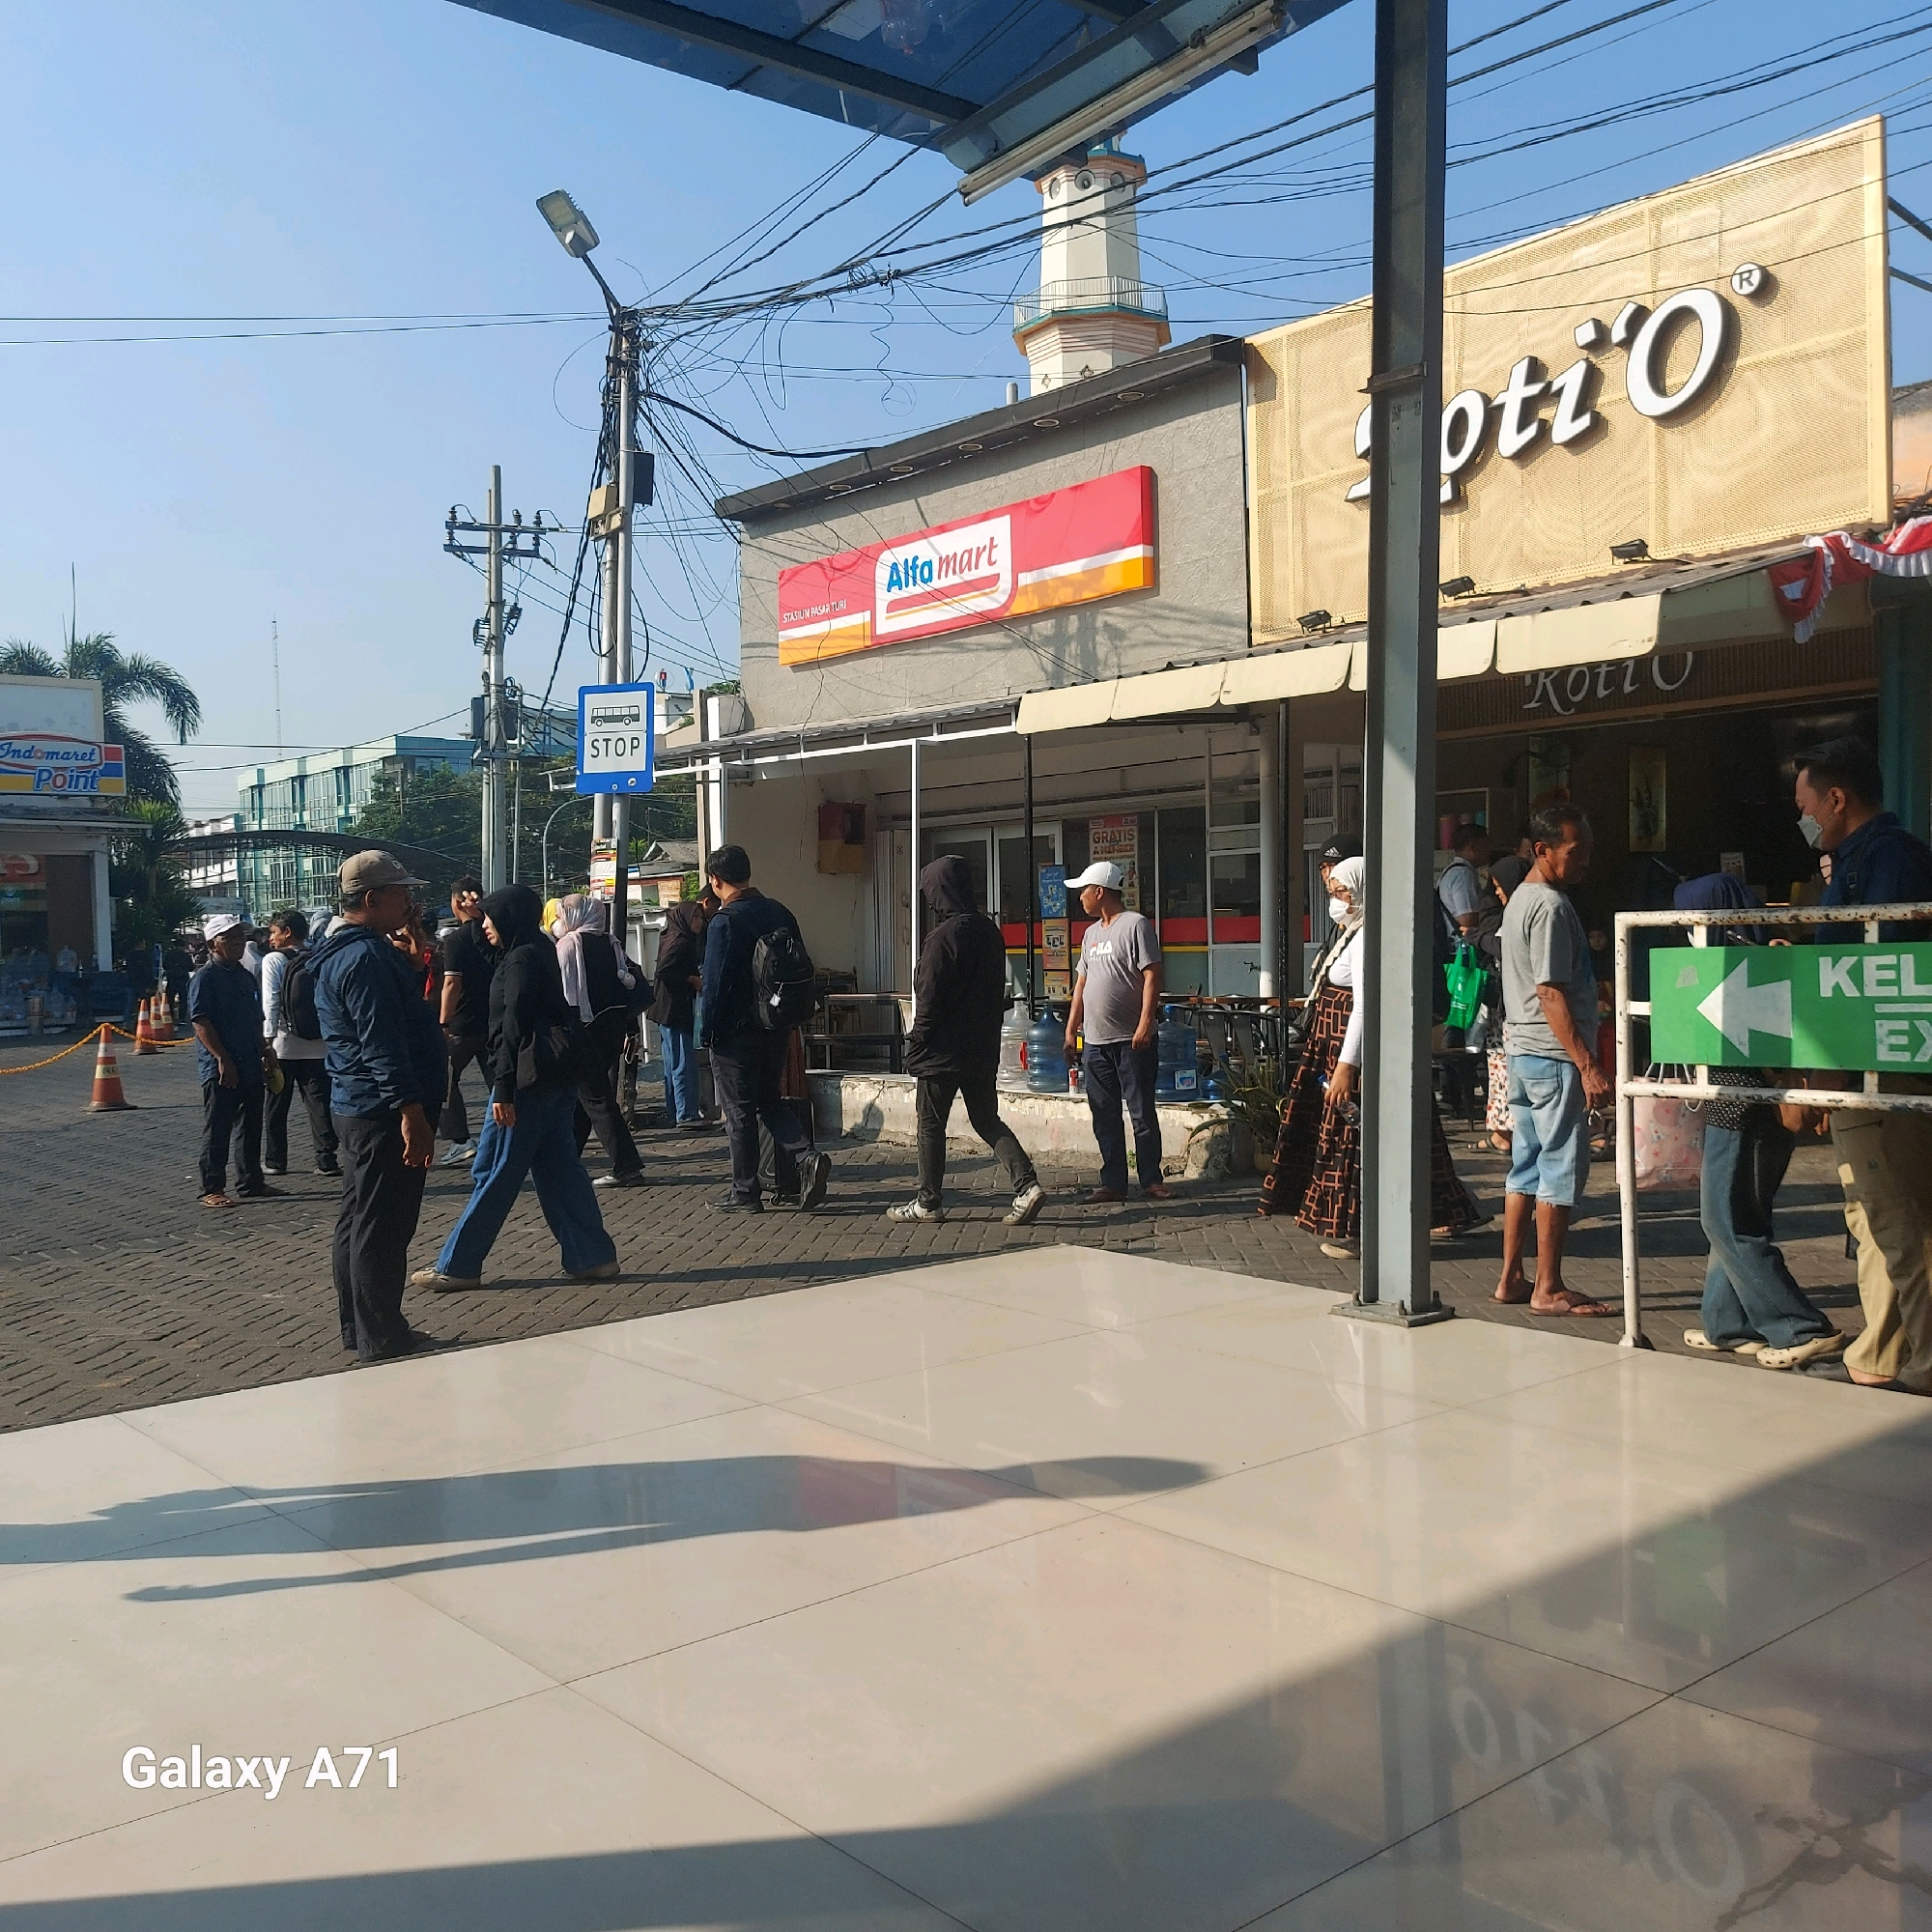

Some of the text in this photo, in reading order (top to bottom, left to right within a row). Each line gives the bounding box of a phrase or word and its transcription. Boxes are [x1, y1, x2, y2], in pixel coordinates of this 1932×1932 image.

[886, 536, 999, 593] Alfamart
[782, 599, 847, 624] STASIUN PASAR TURI
[0, 741, 97, 762] Indomaret
[590, 736, 640, 758] STOP
[35, 767, 100, 791] Point
[1093, 828, 1136, 845] GRATIS
[1818, 953, 1932, 997] KEL
